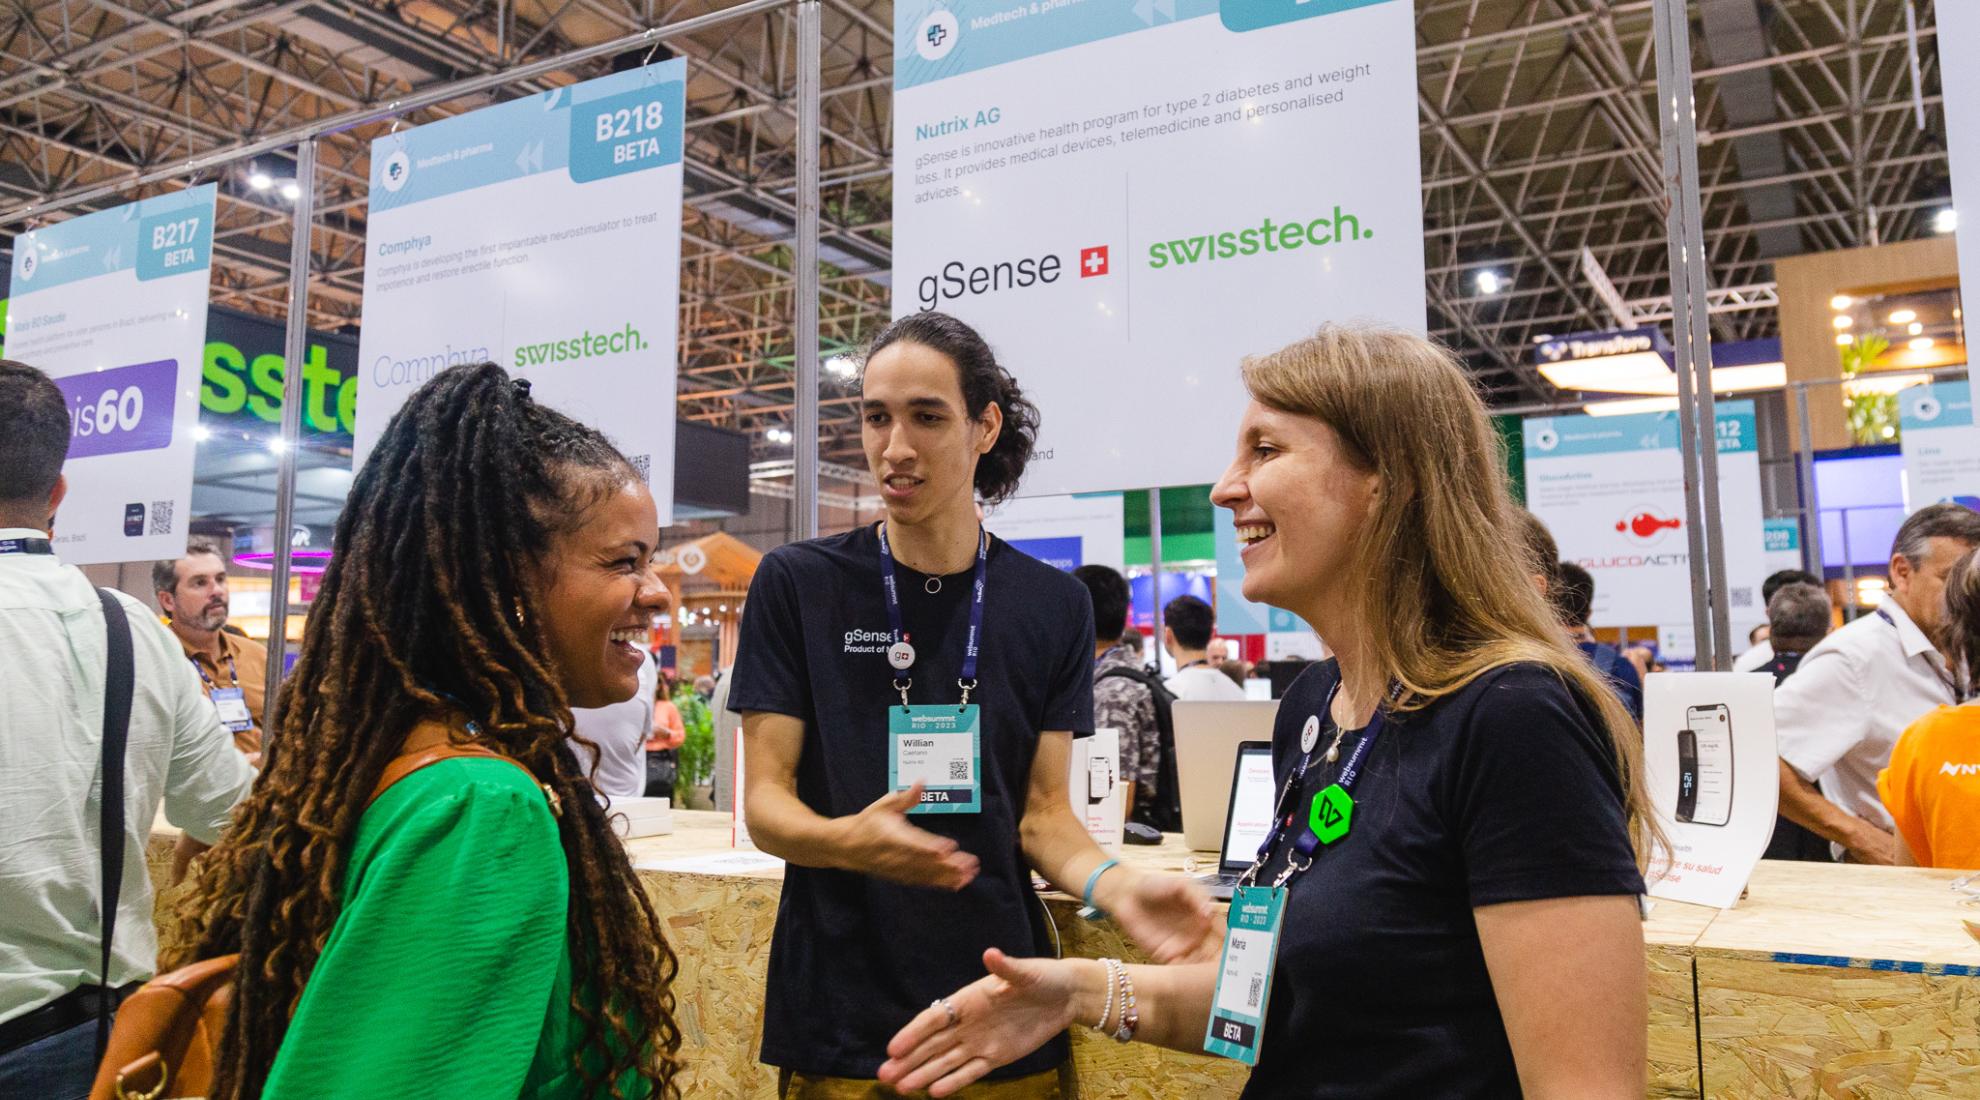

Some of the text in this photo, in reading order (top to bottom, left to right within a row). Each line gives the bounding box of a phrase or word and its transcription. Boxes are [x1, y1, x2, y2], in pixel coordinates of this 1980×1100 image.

[970, 6, 1028, 31] Medtech
[1029, 1, 1040, 16] &
[595, 100, 664, 143] B218
[915, 63, 1371, 170] gSense is innovative health program for type 2 diabetes and weight
[915, 106, 1001, 142] Nutrix AG
[914, 88, 1344, 185] loss. It provides medical devices, telemedicine and personalised
[613, 136, 661, 165] BETA
[914, 185, 962, 204] advices.
[623, 217, 633, 228] to
[635, 211, 657, 224] treat
[152, 217, 200, 250] B217
[1148, 205, 1374, 269] swisstech.
[378, 234, 432, 257] Comphya
[163, 247, 196, 268] BETA
[918, 253, 1061, 312] gSense
[513, 321, 649, 368] swisstech.
[67, 385, 144, 438] is60
[1717, 437, 1742, 449] ETA
[1032, 447, 1054, 461] and
[1578, 553, 1690, 570] GLUCOACTI
[844, 628, 892, 645] gSense
[844, 644, 875, 654] Product
[876, 645, 886, 653] of
[903, 738, 934, 747] Willian
[1344, 770, 1357, 786] RIO
[920, 791, 950, 802] BETA
[1696, 863, 1724, 875] salud
[1223, 1022, 1242, 1043] BETA
